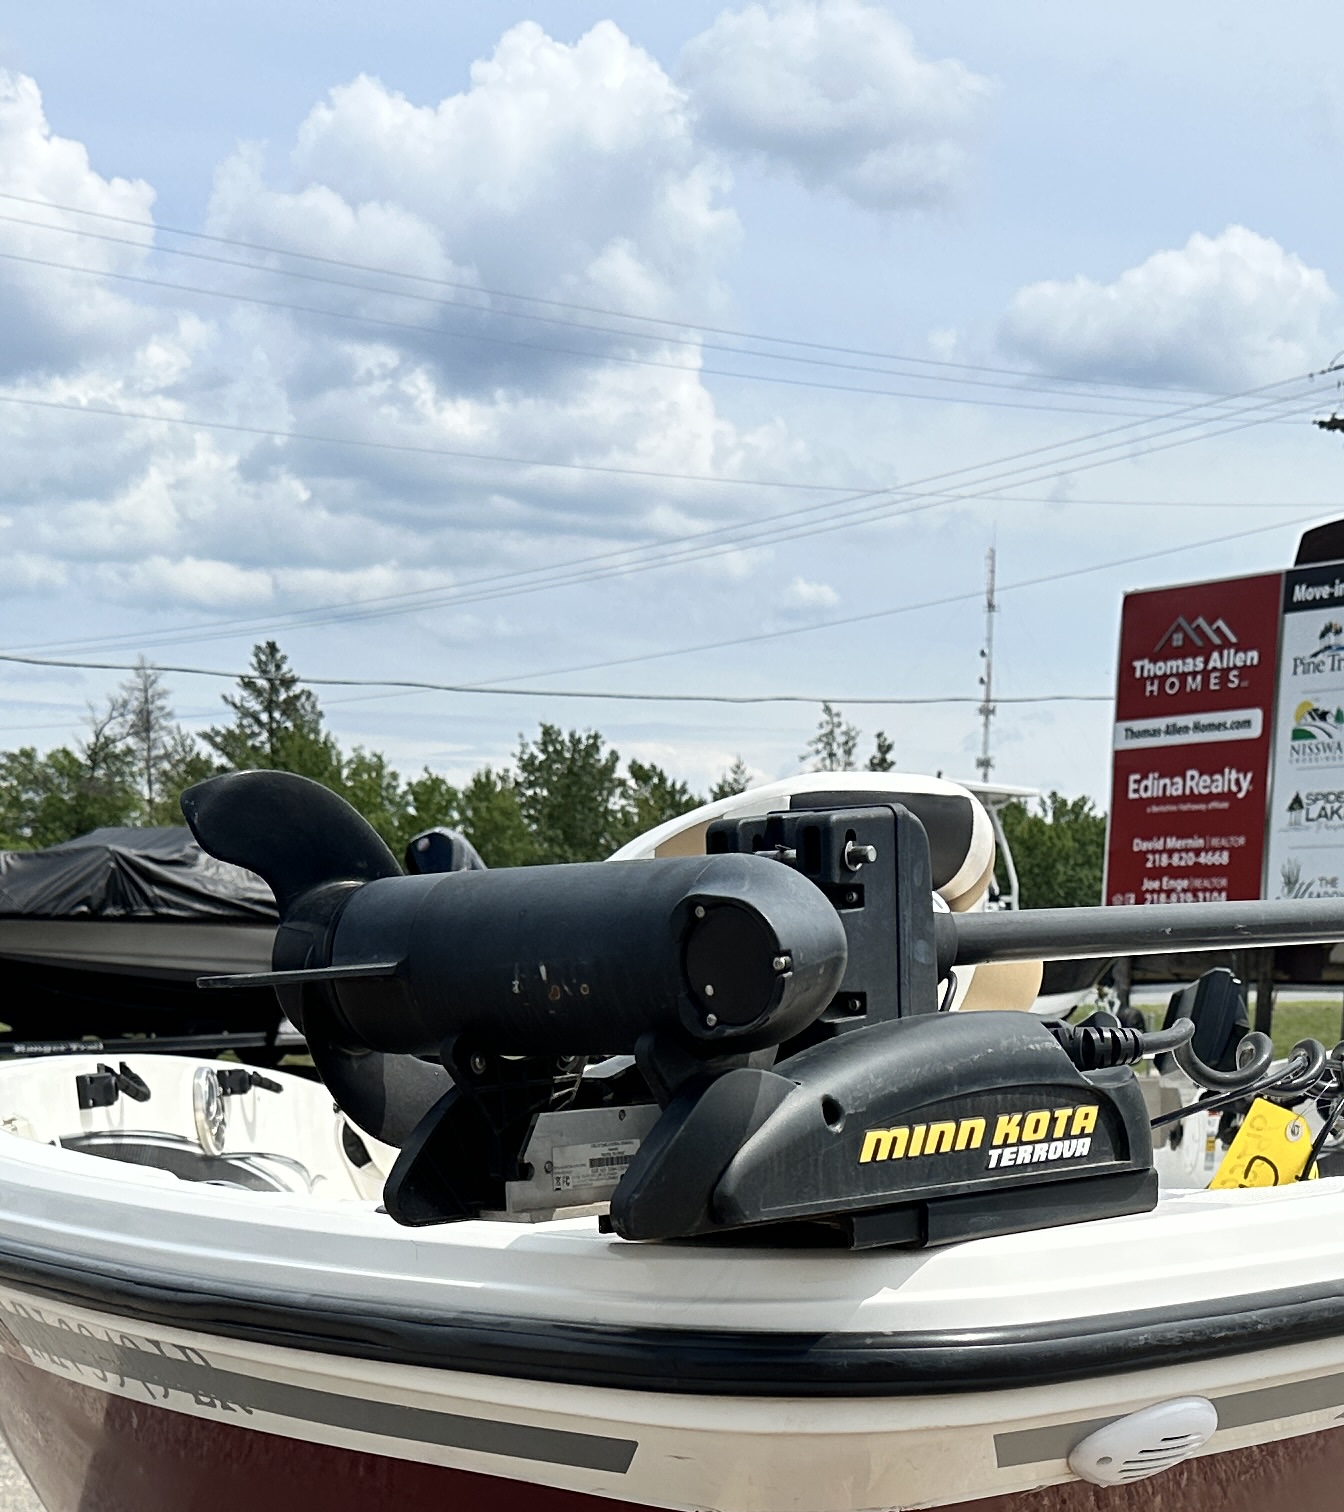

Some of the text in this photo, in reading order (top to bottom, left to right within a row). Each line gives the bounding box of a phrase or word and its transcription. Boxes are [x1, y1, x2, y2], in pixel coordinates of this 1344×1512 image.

[1132, 649, 1259, 679] Thomas Allen
[1292, 655, 1326, 676] Pine
[1145, 670, 1240, 697] HOMES
[1290, 740, 1344, 757] NISSWA
[1317, 875, 1340, 888] THE
[859, 1104, 1100, 1164] MINN KOTA
[987, 1137, 1092, 1170] TERROVA
